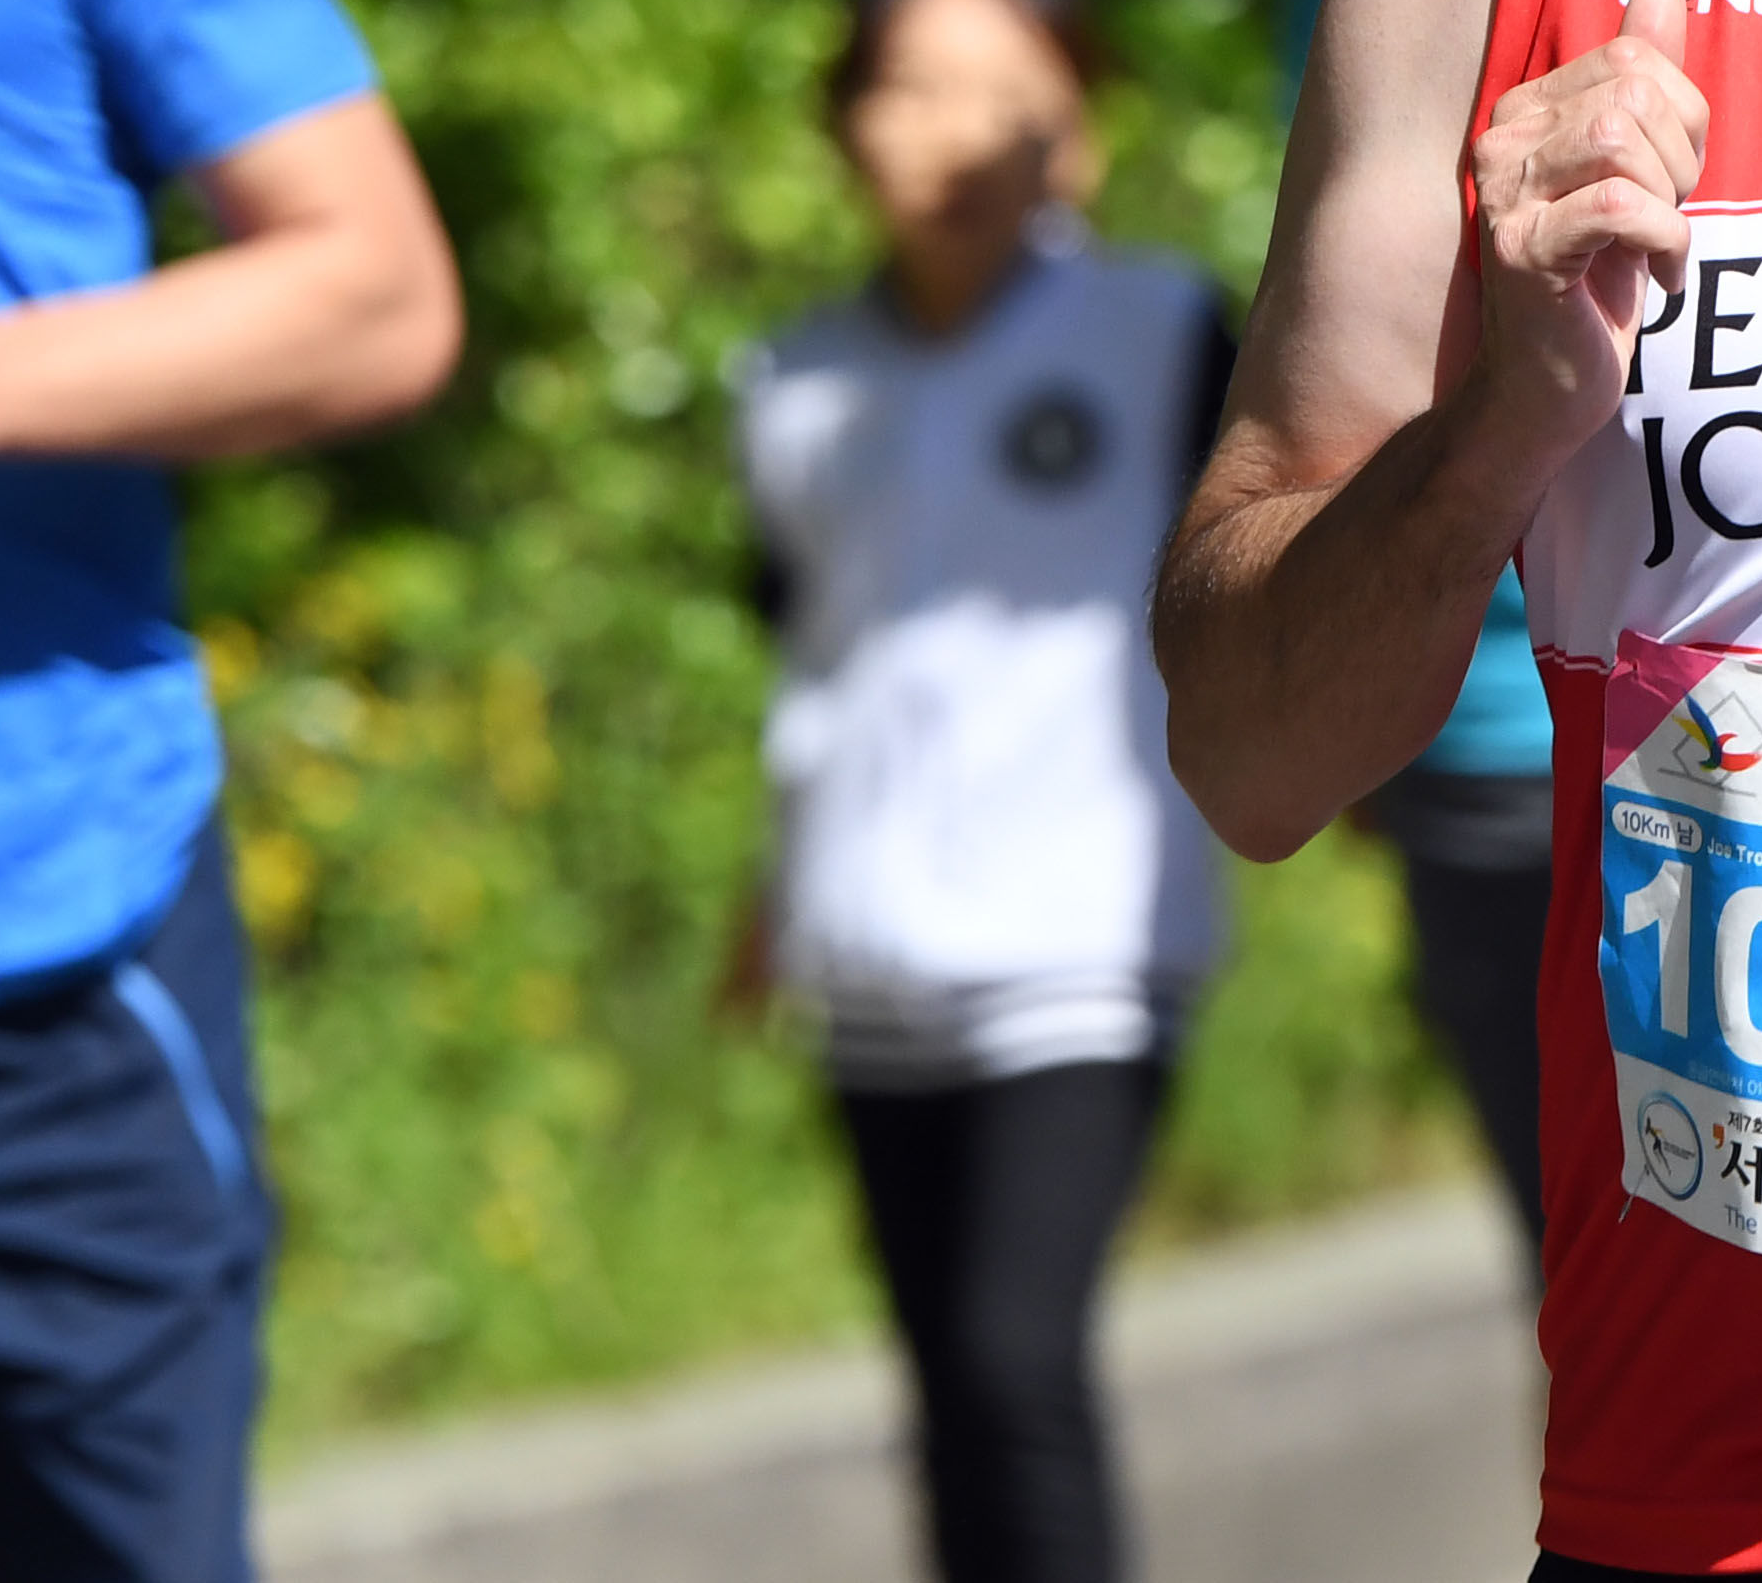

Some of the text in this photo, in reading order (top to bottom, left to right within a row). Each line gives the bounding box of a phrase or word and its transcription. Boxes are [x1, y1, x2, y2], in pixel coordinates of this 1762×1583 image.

[1621, 809, 1694, 847] 10Km 남
[1724, 1203, 1758, 1235] The
